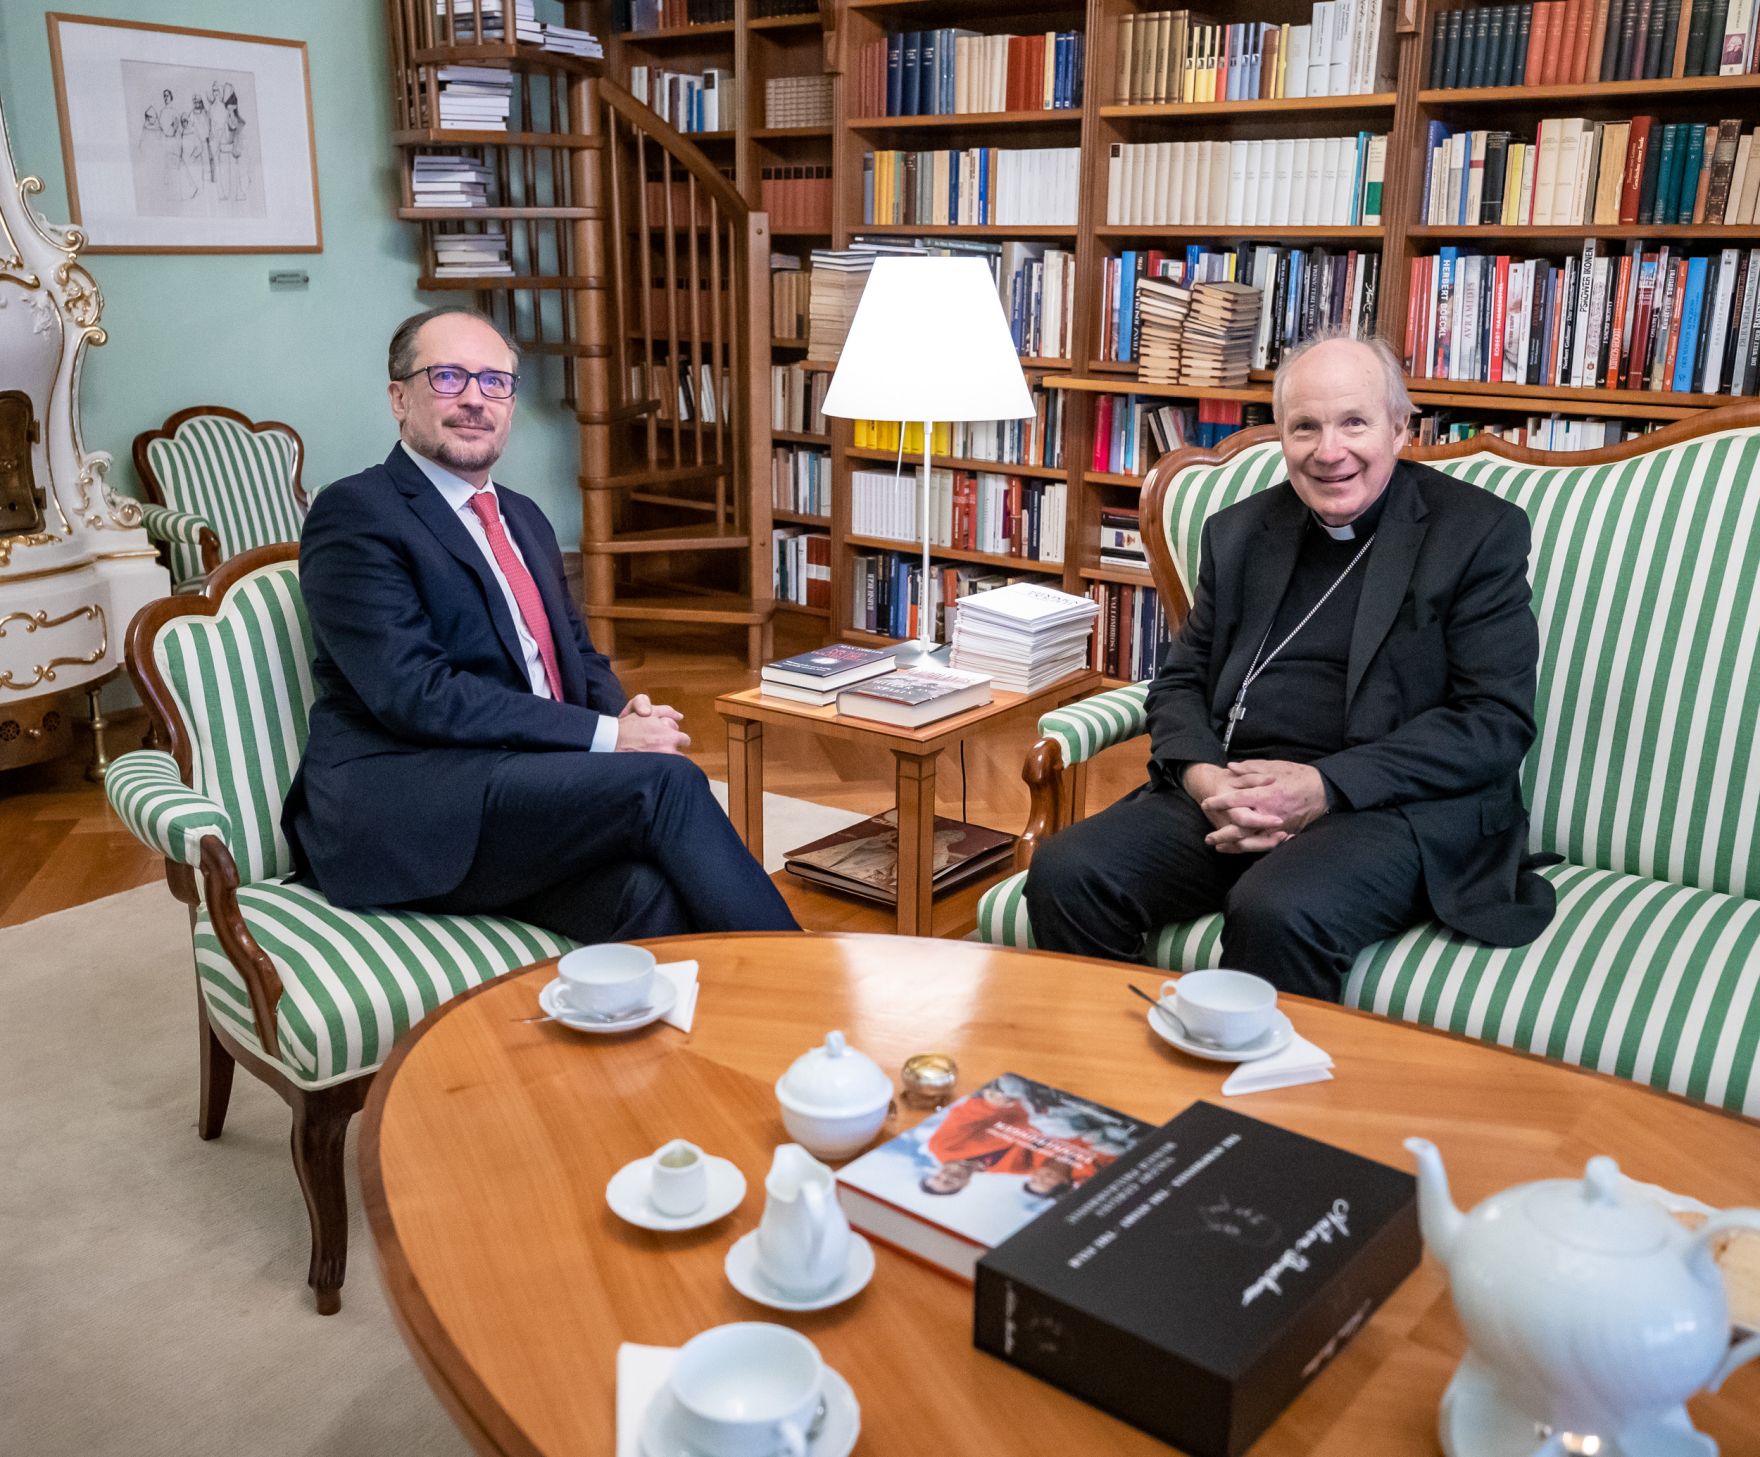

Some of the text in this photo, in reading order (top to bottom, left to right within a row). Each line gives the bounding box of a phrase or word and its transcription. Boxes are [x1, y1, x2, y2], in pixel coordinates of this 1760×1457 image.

[1438, 259, 1450, 339] HERBERT BOECKL
[1463, 281, 1475, 339] AVRAMIDIS
[1579, 246, 1594, 313] PSKOWER IKONEN
[1109, 595, 1119, 654] VALLOMBROSA
